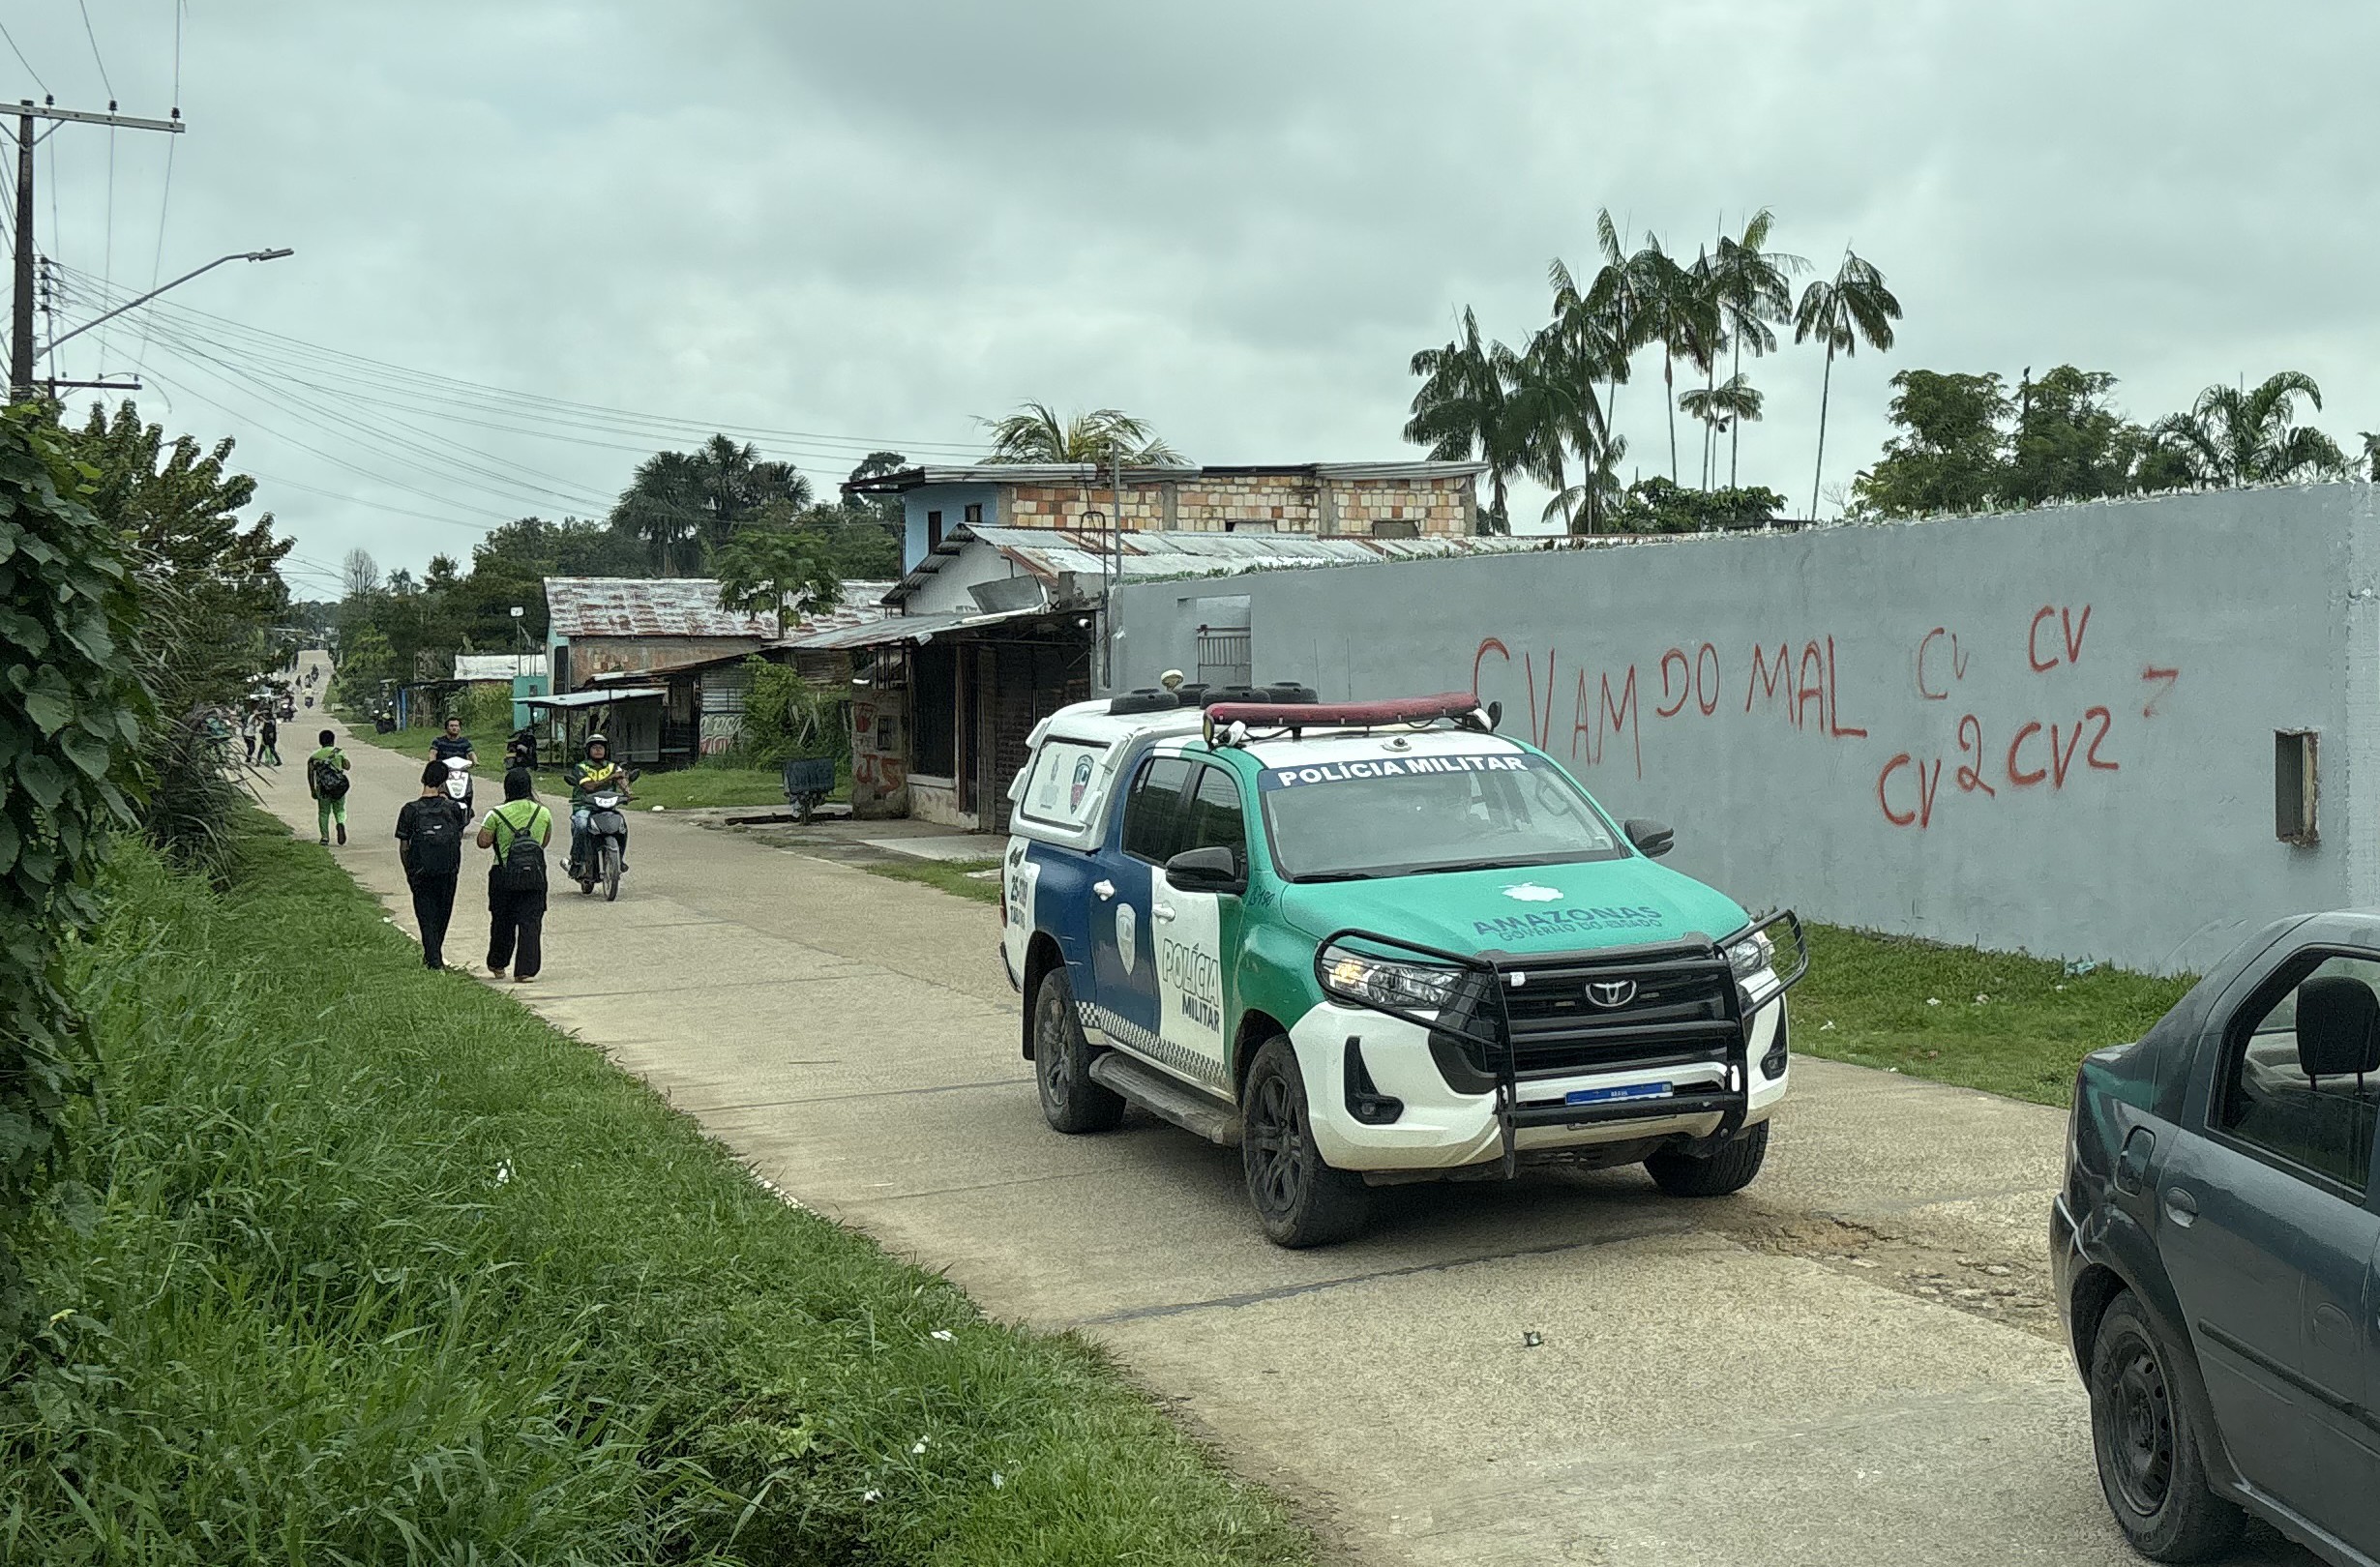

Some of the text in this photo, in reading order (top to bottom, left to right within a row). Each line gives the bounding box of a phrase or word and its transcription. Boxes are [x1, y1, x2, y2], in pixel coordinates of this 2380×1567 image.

[2029, 605, 2091, 672] CV
[1656, 642, 1720, 717] DO
[1745, 635, 1868, 738] MAL
[1277, 755, 1529, 787] POLÍCIA MILITAR
[1473, 906, 1663, 935] AMAZONAS
[1500, 921, 1577, 942] GOVERNO
[1578, 921, 1603, 931] DO
[1162, 937, 1219, 1009] POLÍCIA
[1182, 993, 1220, 1034] MILITAR
